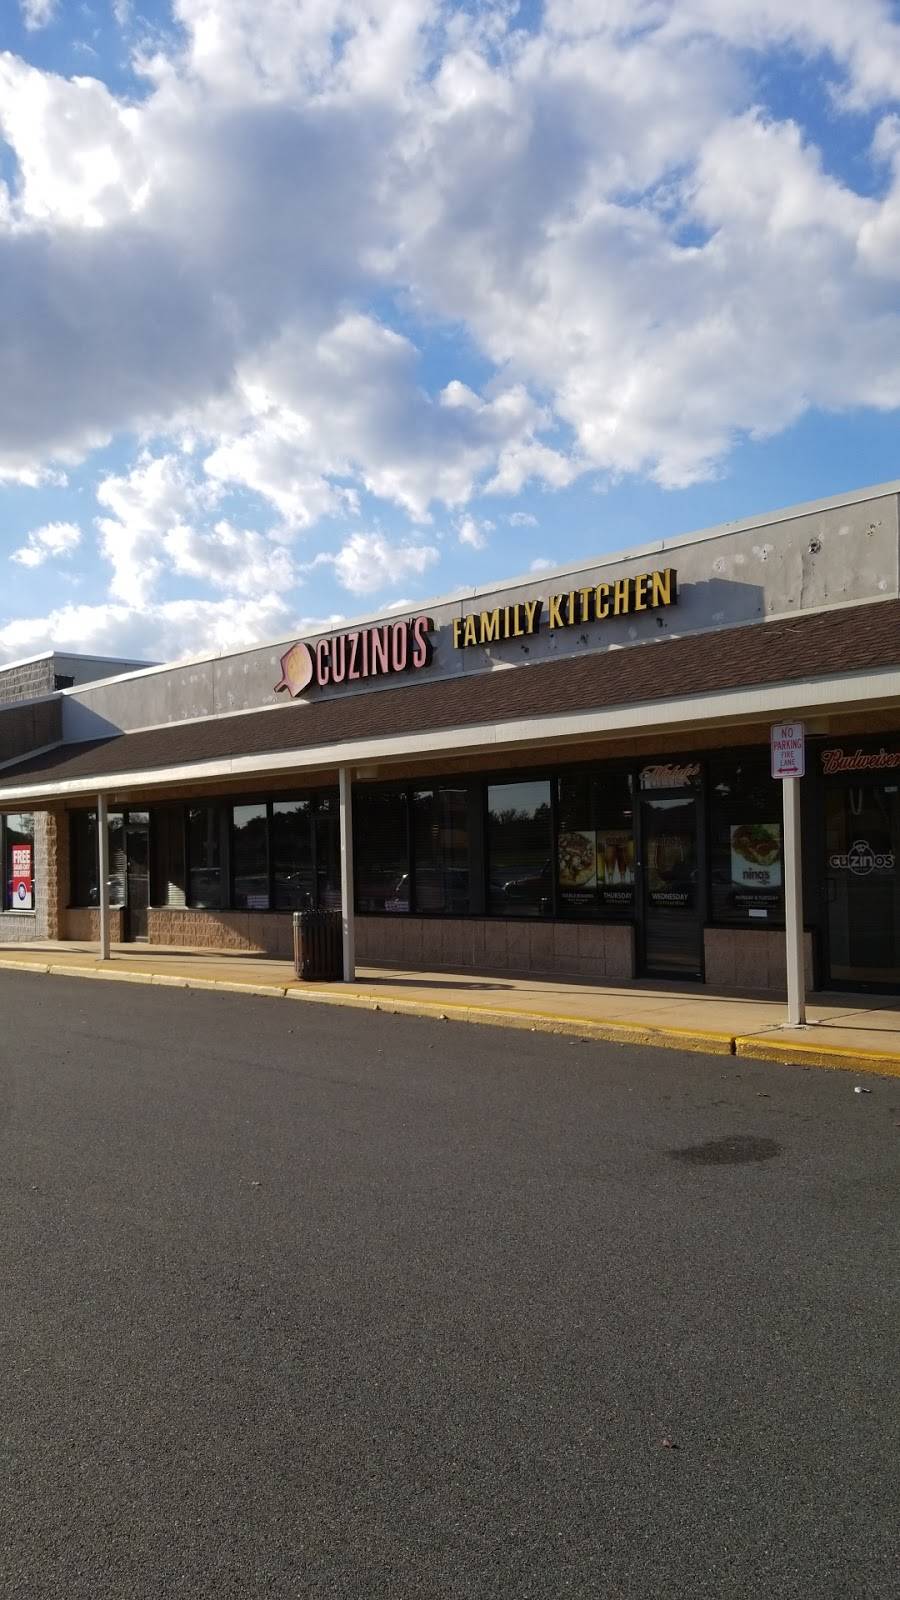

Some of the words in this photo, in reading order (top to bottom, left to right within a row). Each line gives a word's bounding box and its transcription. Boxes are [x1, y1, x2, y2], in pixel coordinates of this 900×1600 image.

[314, 616, 432, 687] CUZINO'S
[452, 600, 541, 649] FAMILY
[548, 568, 676, 629] KITCHEN
[781, 727, 794, 738] NO
[773, 738, 802, 750] PARKING
[781, 750, 795, 759] FIRE
[780, 758, 796, 767] LANE
[822, 747, 900, 774] Budweiser
[13, 849, 31, 864] FREE
[603, 891, 632, 899] THURSDAY
[651, 893, 688, 901] WEDNESDAY
